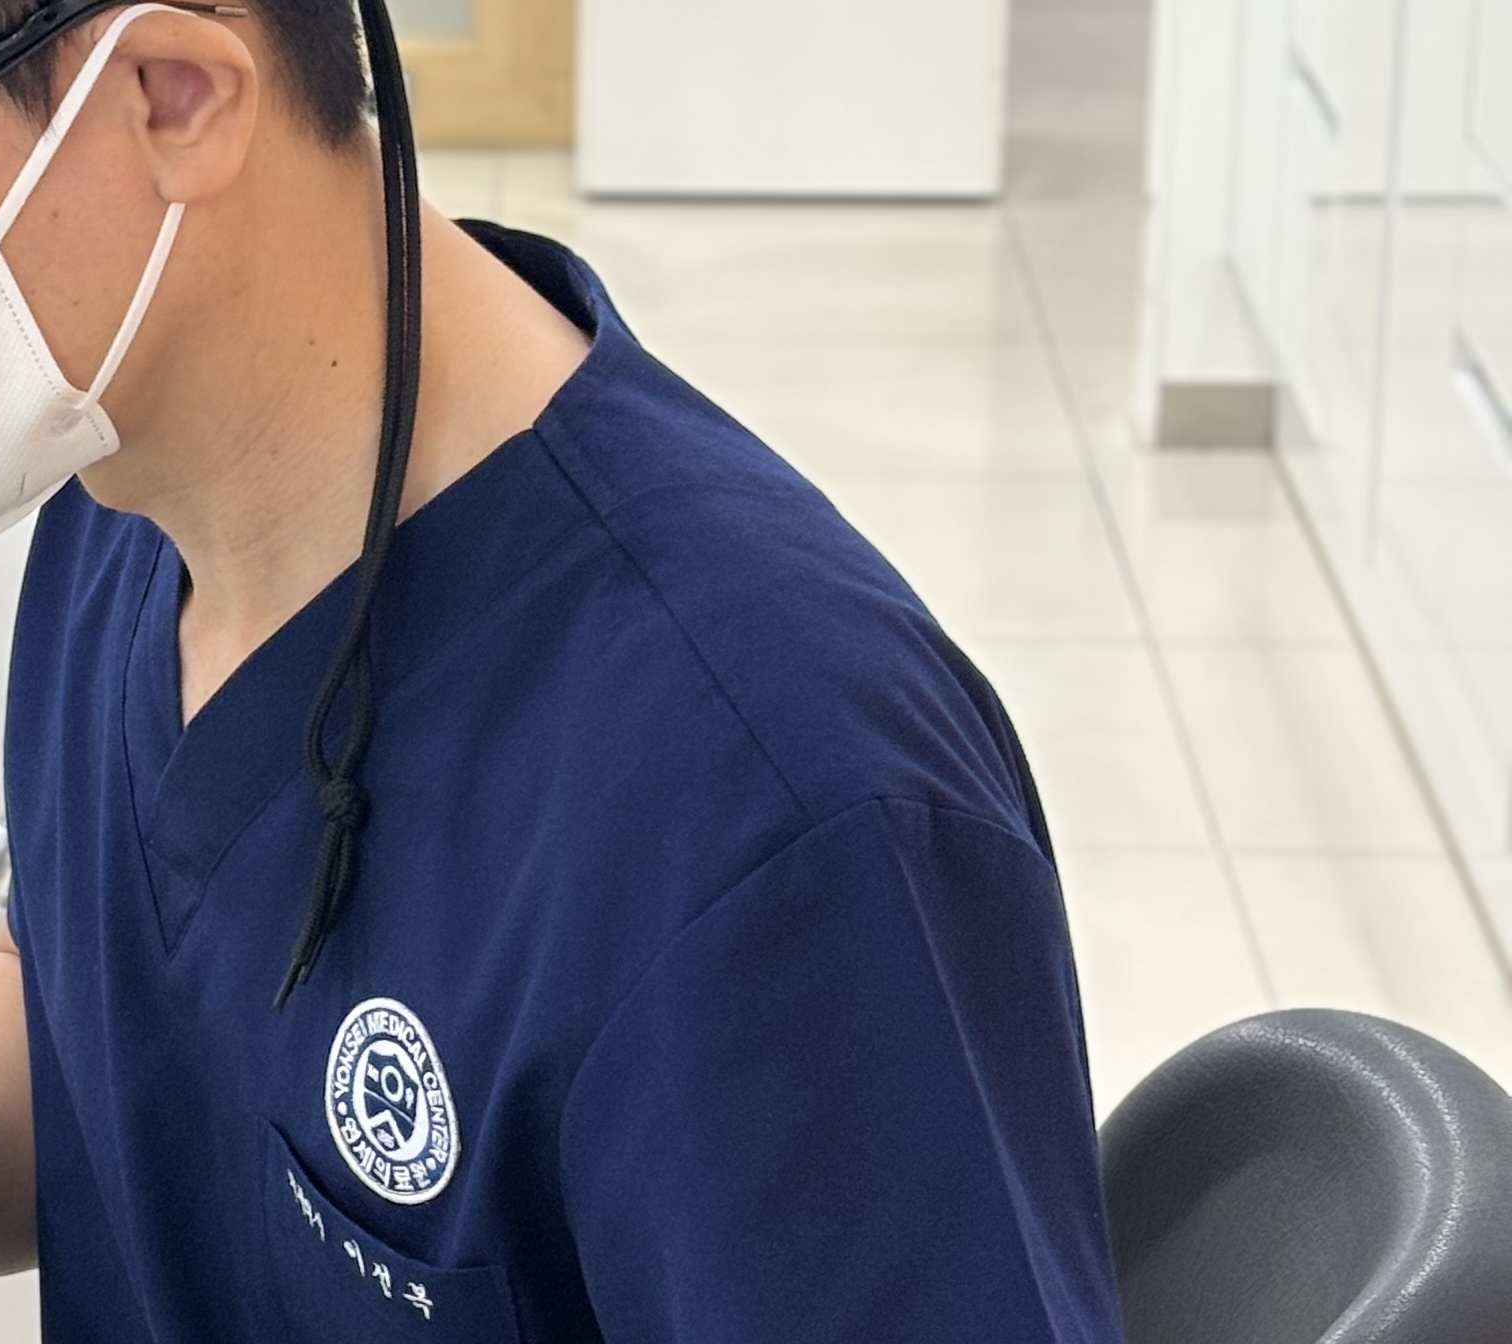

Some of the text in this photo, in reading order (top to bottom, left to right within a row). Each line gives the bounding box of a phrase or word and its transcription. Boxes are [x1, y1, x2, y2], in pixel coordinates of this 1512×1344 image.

[335, 1010, 450, 1164] YONSEI MEDICAL CENTER
